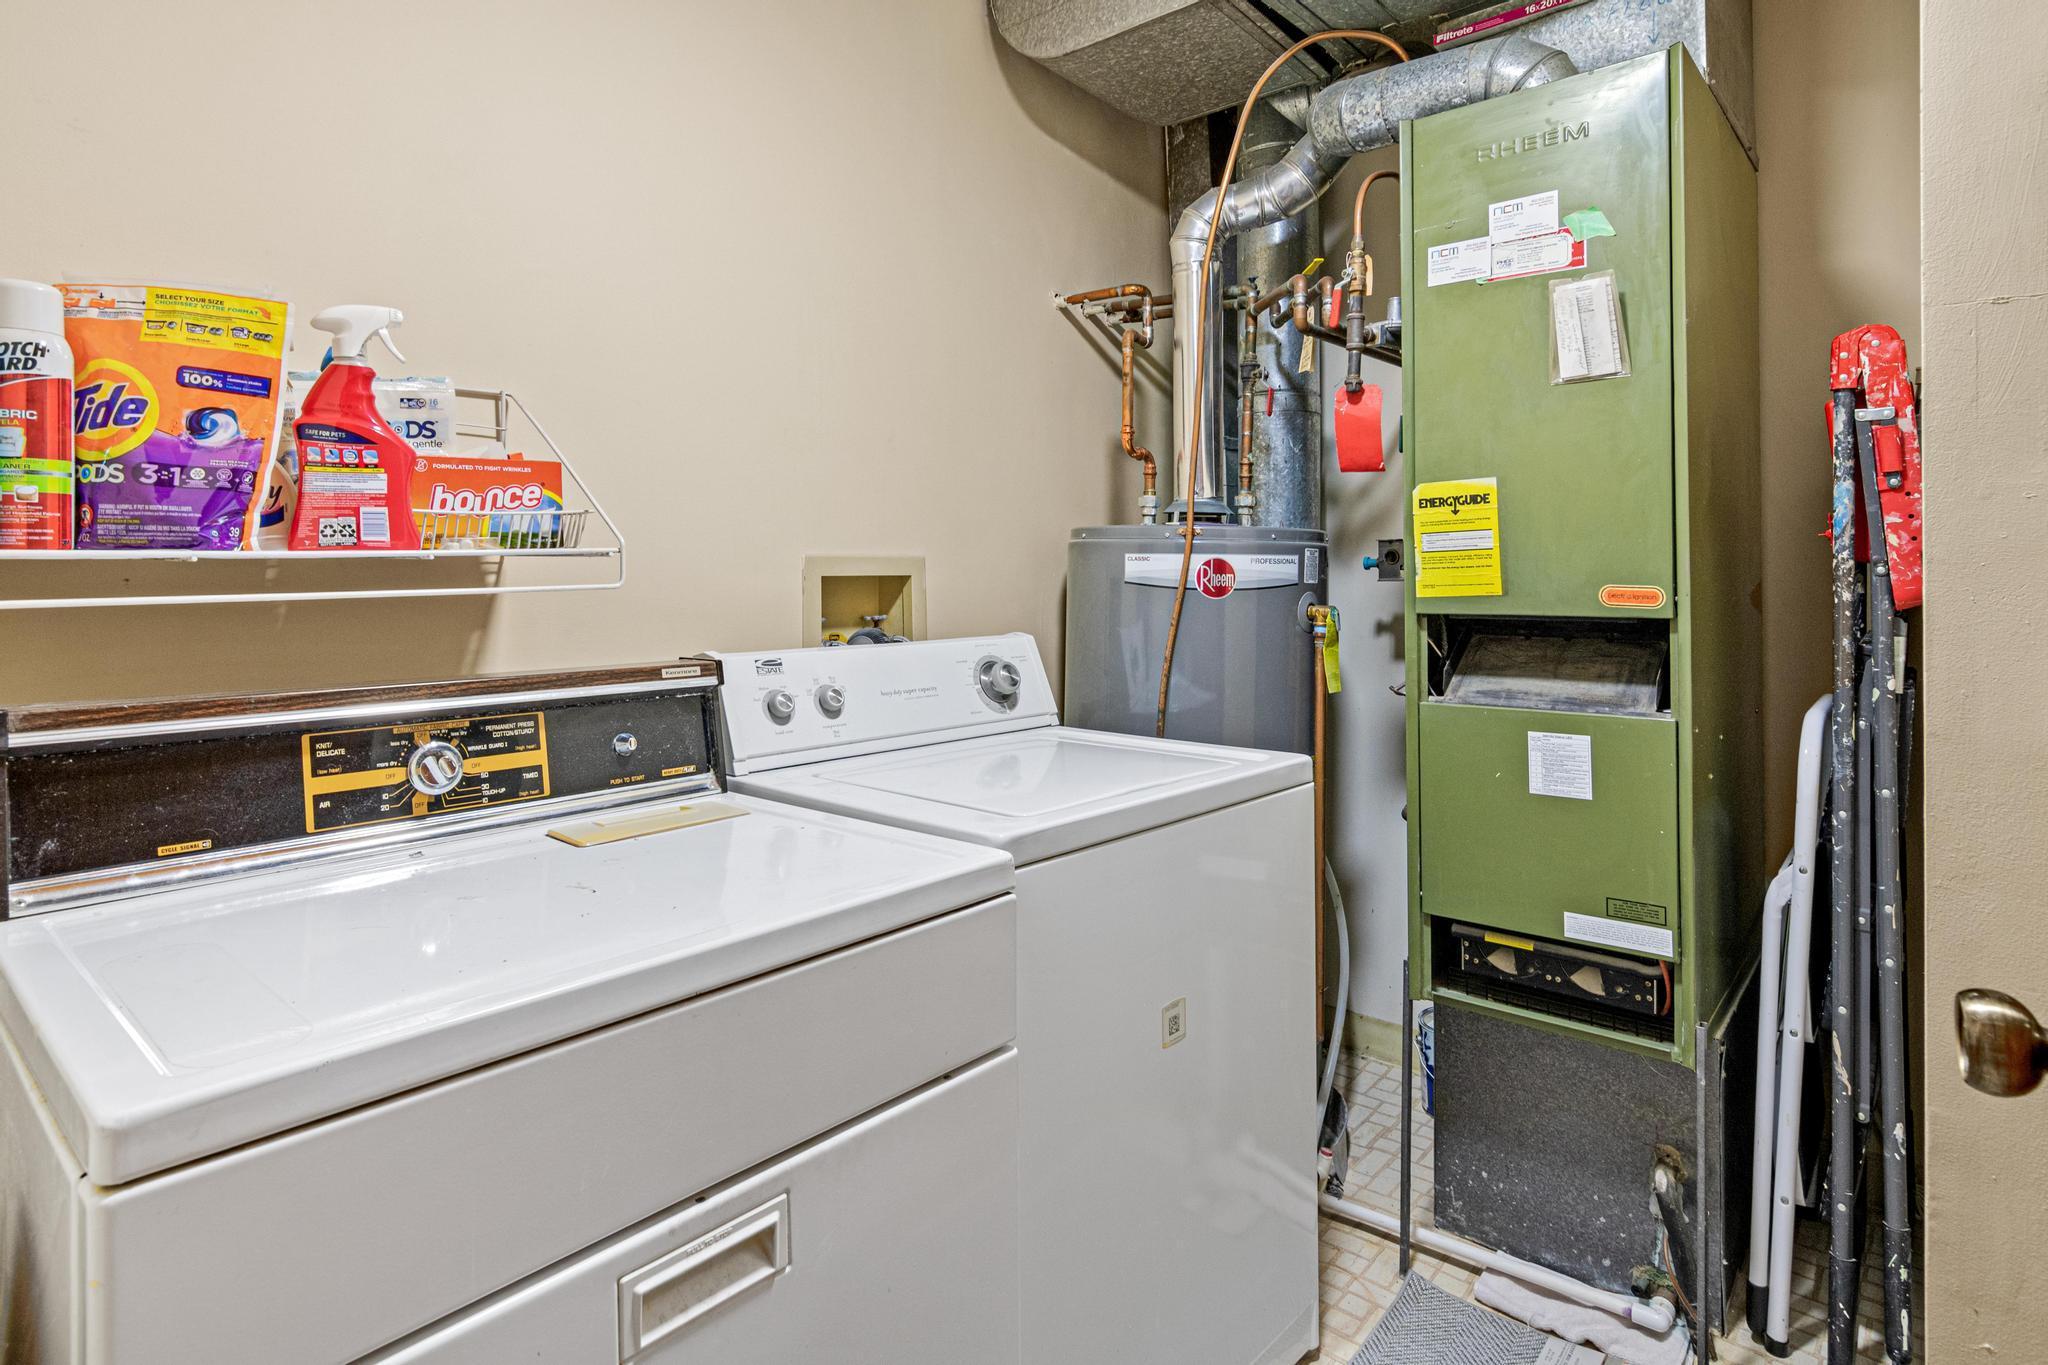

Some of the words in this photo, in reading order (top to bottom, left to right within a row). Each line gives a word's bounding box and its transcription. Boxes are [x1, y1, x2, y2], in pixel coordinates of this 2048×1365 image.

[1436, 26, 1474, 43] Filtrete
[1477, 120, 1590, 163] RHEEM
[155, 293, 183, 301] SELECT
[185, 295, 206, 303] YOUR
[207, 298, 225, 306] SIZE
[154, 299, 199, 309] CHOISISSEZ
[200, 303, 225, 311] VOTRE
[227, 307, 259, 316] FORMAT
[182, 372, 223, 388] 100%
[75, 382, 149, 435] Tide
[319, 429, 329, 437] FOR
[330, 430, 346, 438] PETS
[413, 440, 443, 448] gentle
[432, 463, 474, 471] FORMULATED
[430, 483, 542, 517] bounce
[1419, 493, 1491, 509] ENERGYGUIDE
[229, 526, 240, 537] 39
[1250, 557, 1297, 565] PROFESSIONAL
[1200, 559, 1234, 593] Rheem
[485, 722, 516, 732] PERMANENT
[517, 720, 535, 728] PRESS
[316, 748, 346, 758] DELICATE
[522, 771, 539, 779] TIMED
[319, 801, 331, 809] AIR
[380, 804, 390, 812] 20
[180, 843, 200, 851] SIGNAL
